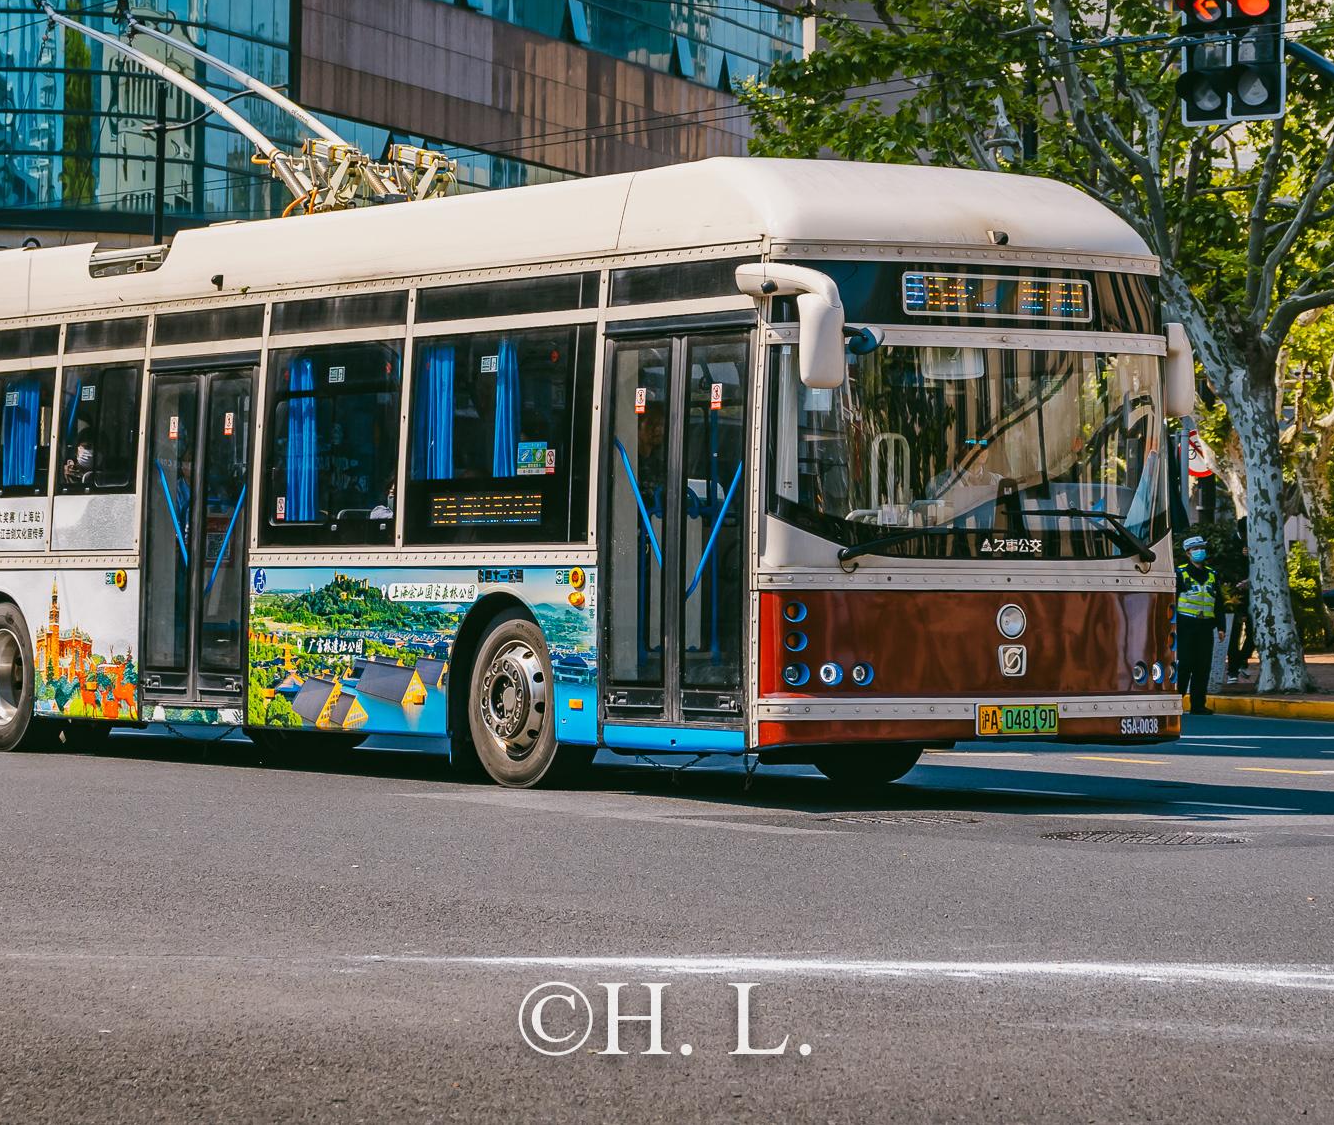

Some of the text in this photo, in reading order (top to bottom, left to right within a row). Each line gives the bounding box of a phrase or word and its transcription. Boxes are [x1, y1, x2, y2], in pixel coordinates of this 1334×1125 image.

[993, 538, 1042, 553] 久事公交
[1121, 718, 1159, 735] S5A-0038
